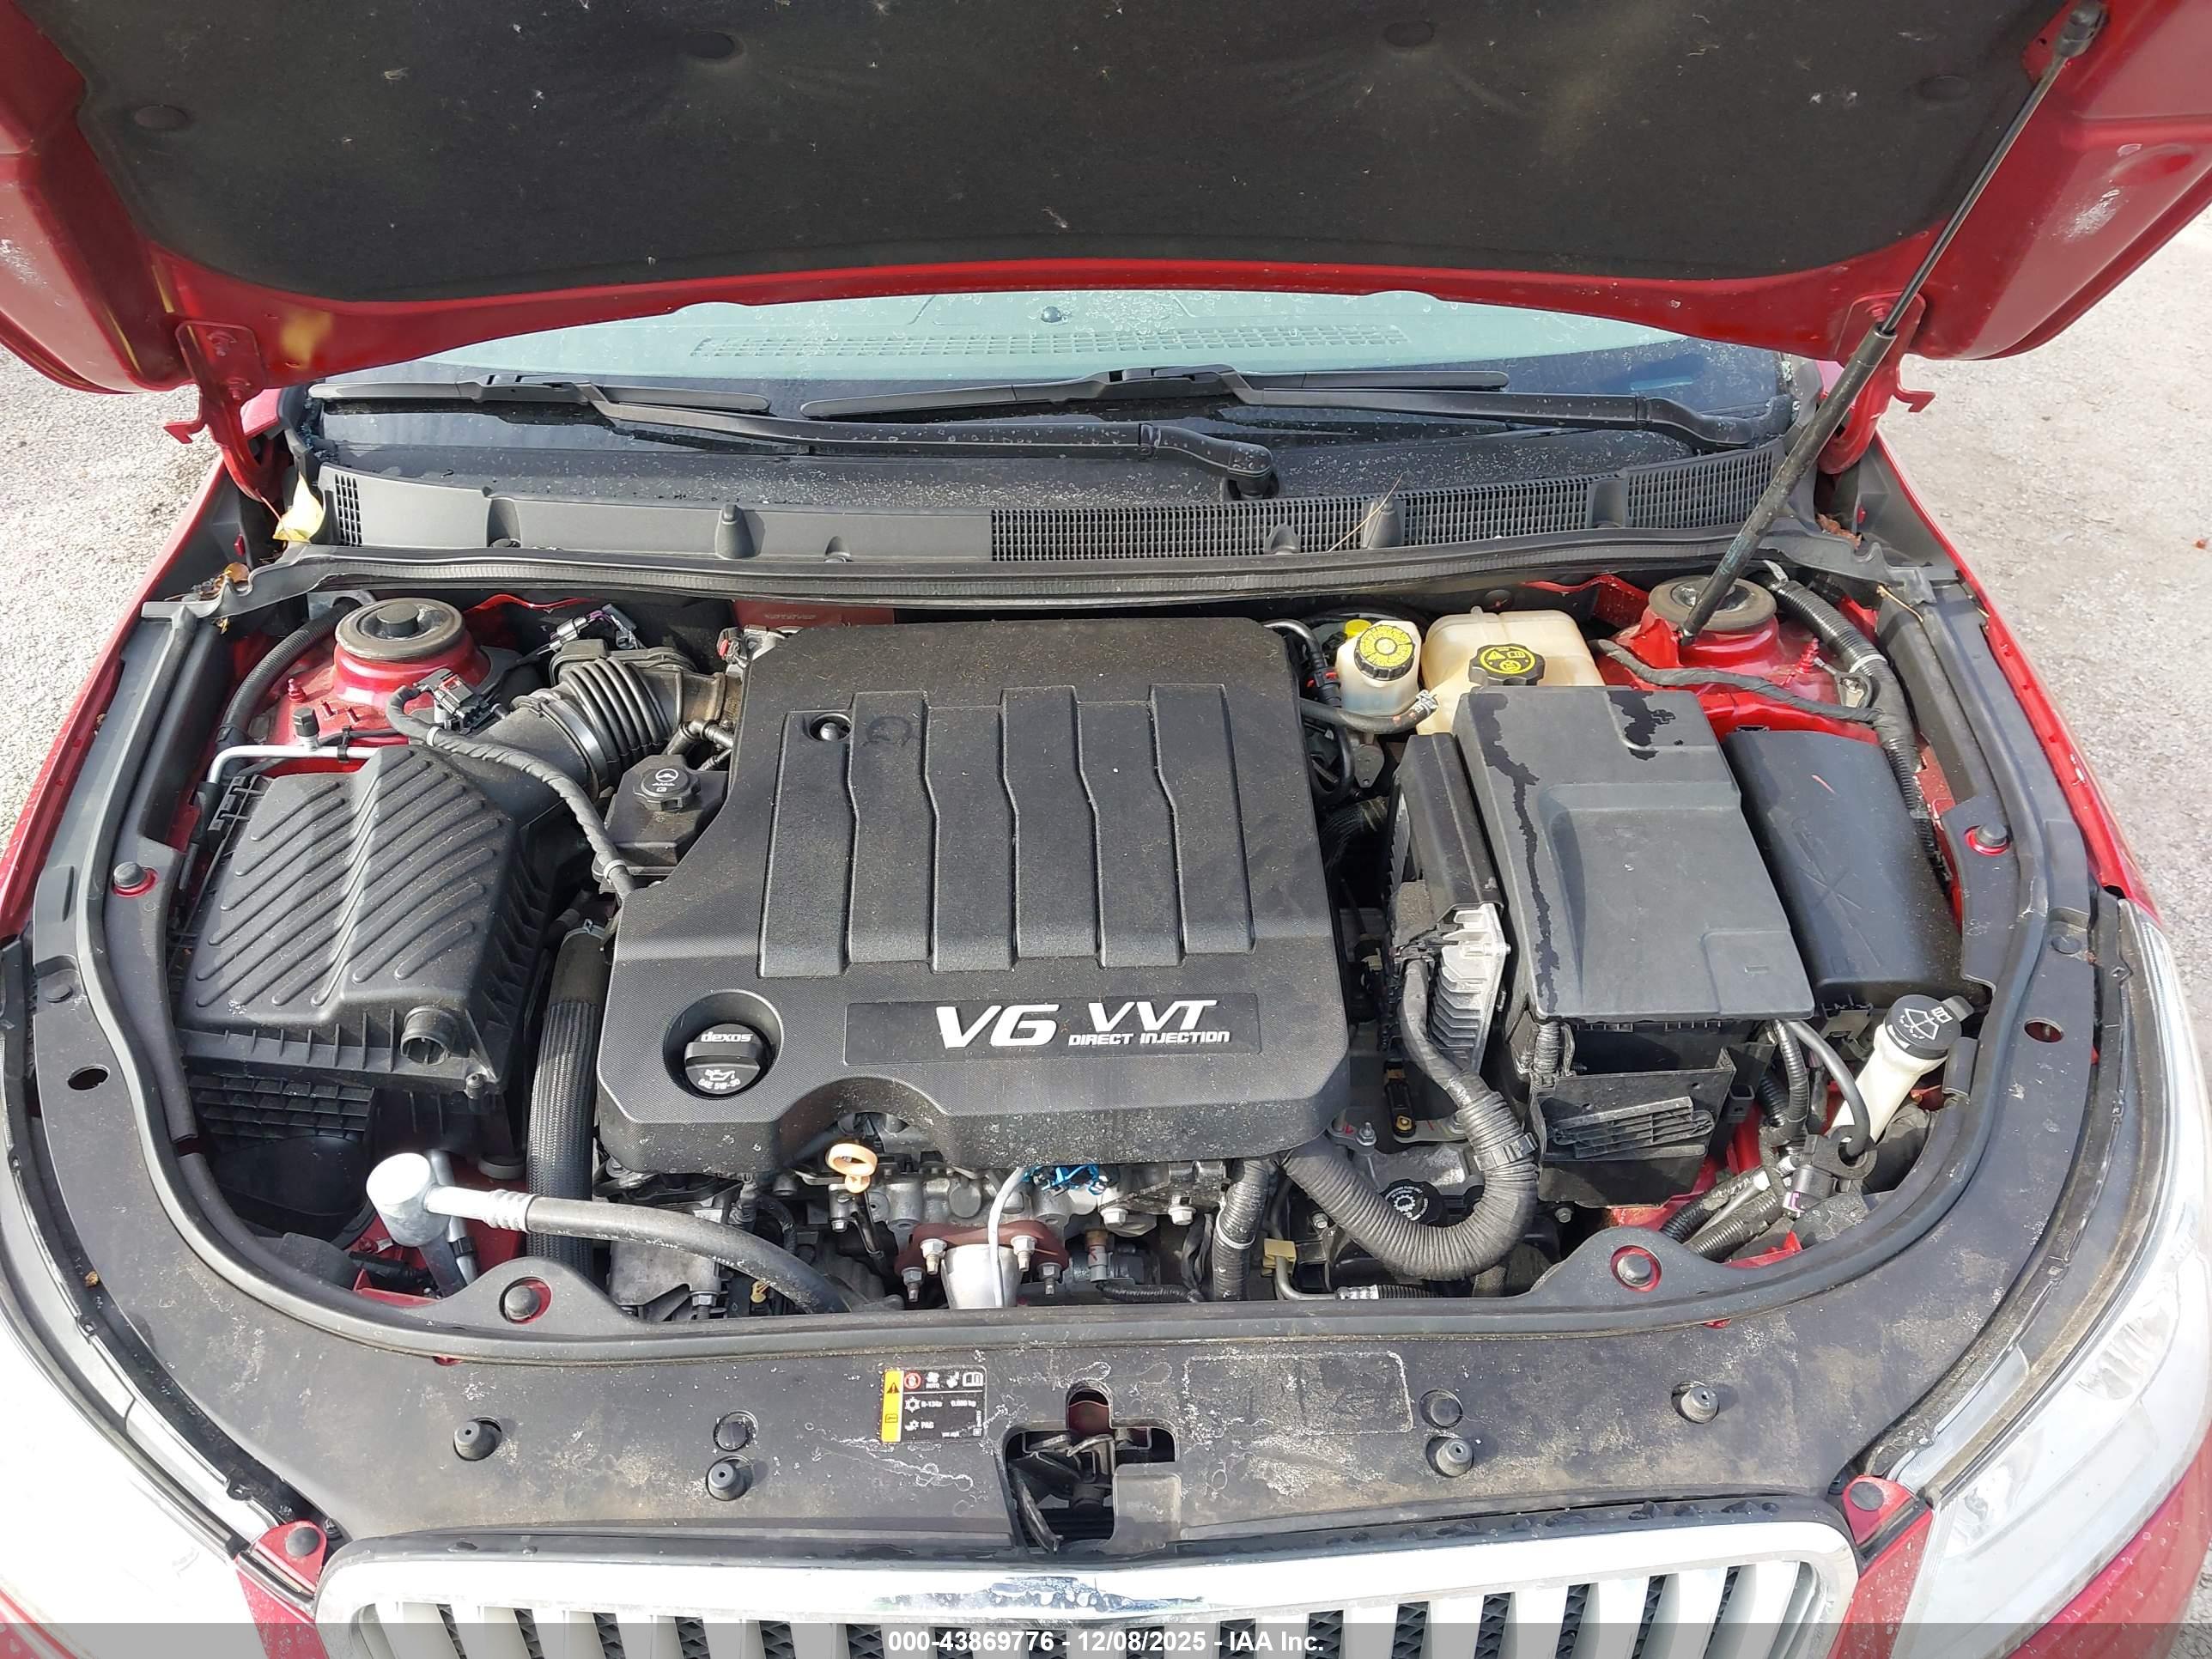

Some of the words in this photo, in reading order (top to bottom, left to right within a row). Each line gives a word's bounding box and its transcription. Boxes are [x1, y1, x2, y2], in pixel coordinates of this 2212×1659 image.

[936, 1004, 1060, 1049] V6
[1088, 1000, 1218, 1032] VVT
[701, 1031, 754, 1042] dexos
[1068, 1033, 1134, 1047] DIRECT
[1139, 1031, 1231, 1044] INJECTION
